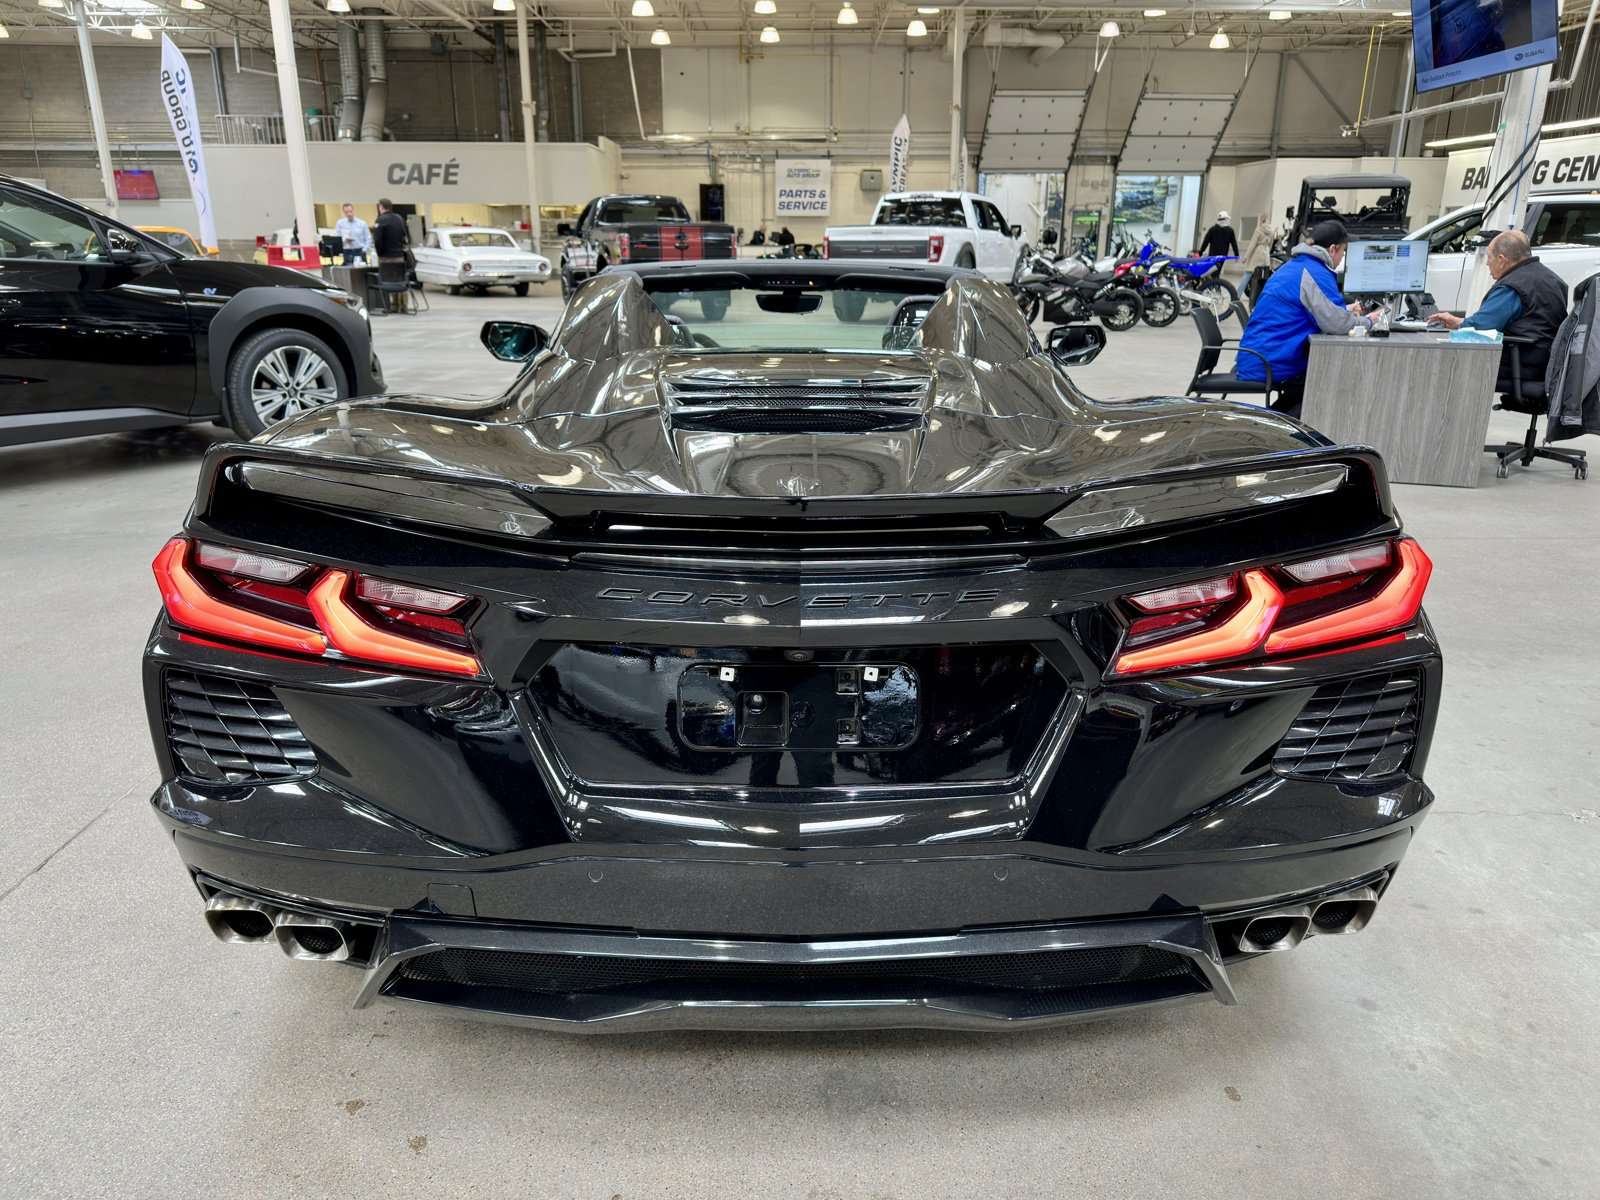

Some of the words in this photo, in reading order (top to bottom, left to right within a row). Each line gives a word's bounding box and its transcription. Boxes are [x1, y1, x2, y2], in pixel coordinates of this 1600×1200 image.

[387, 157, 460, 185] CAFÉ
[779, 189, 816, 199] PARTS
[818, 189, 827, 199] &
[778, 201, 828, 210] SERVICE
[597, 587, 1001, 609] CORVETTE
